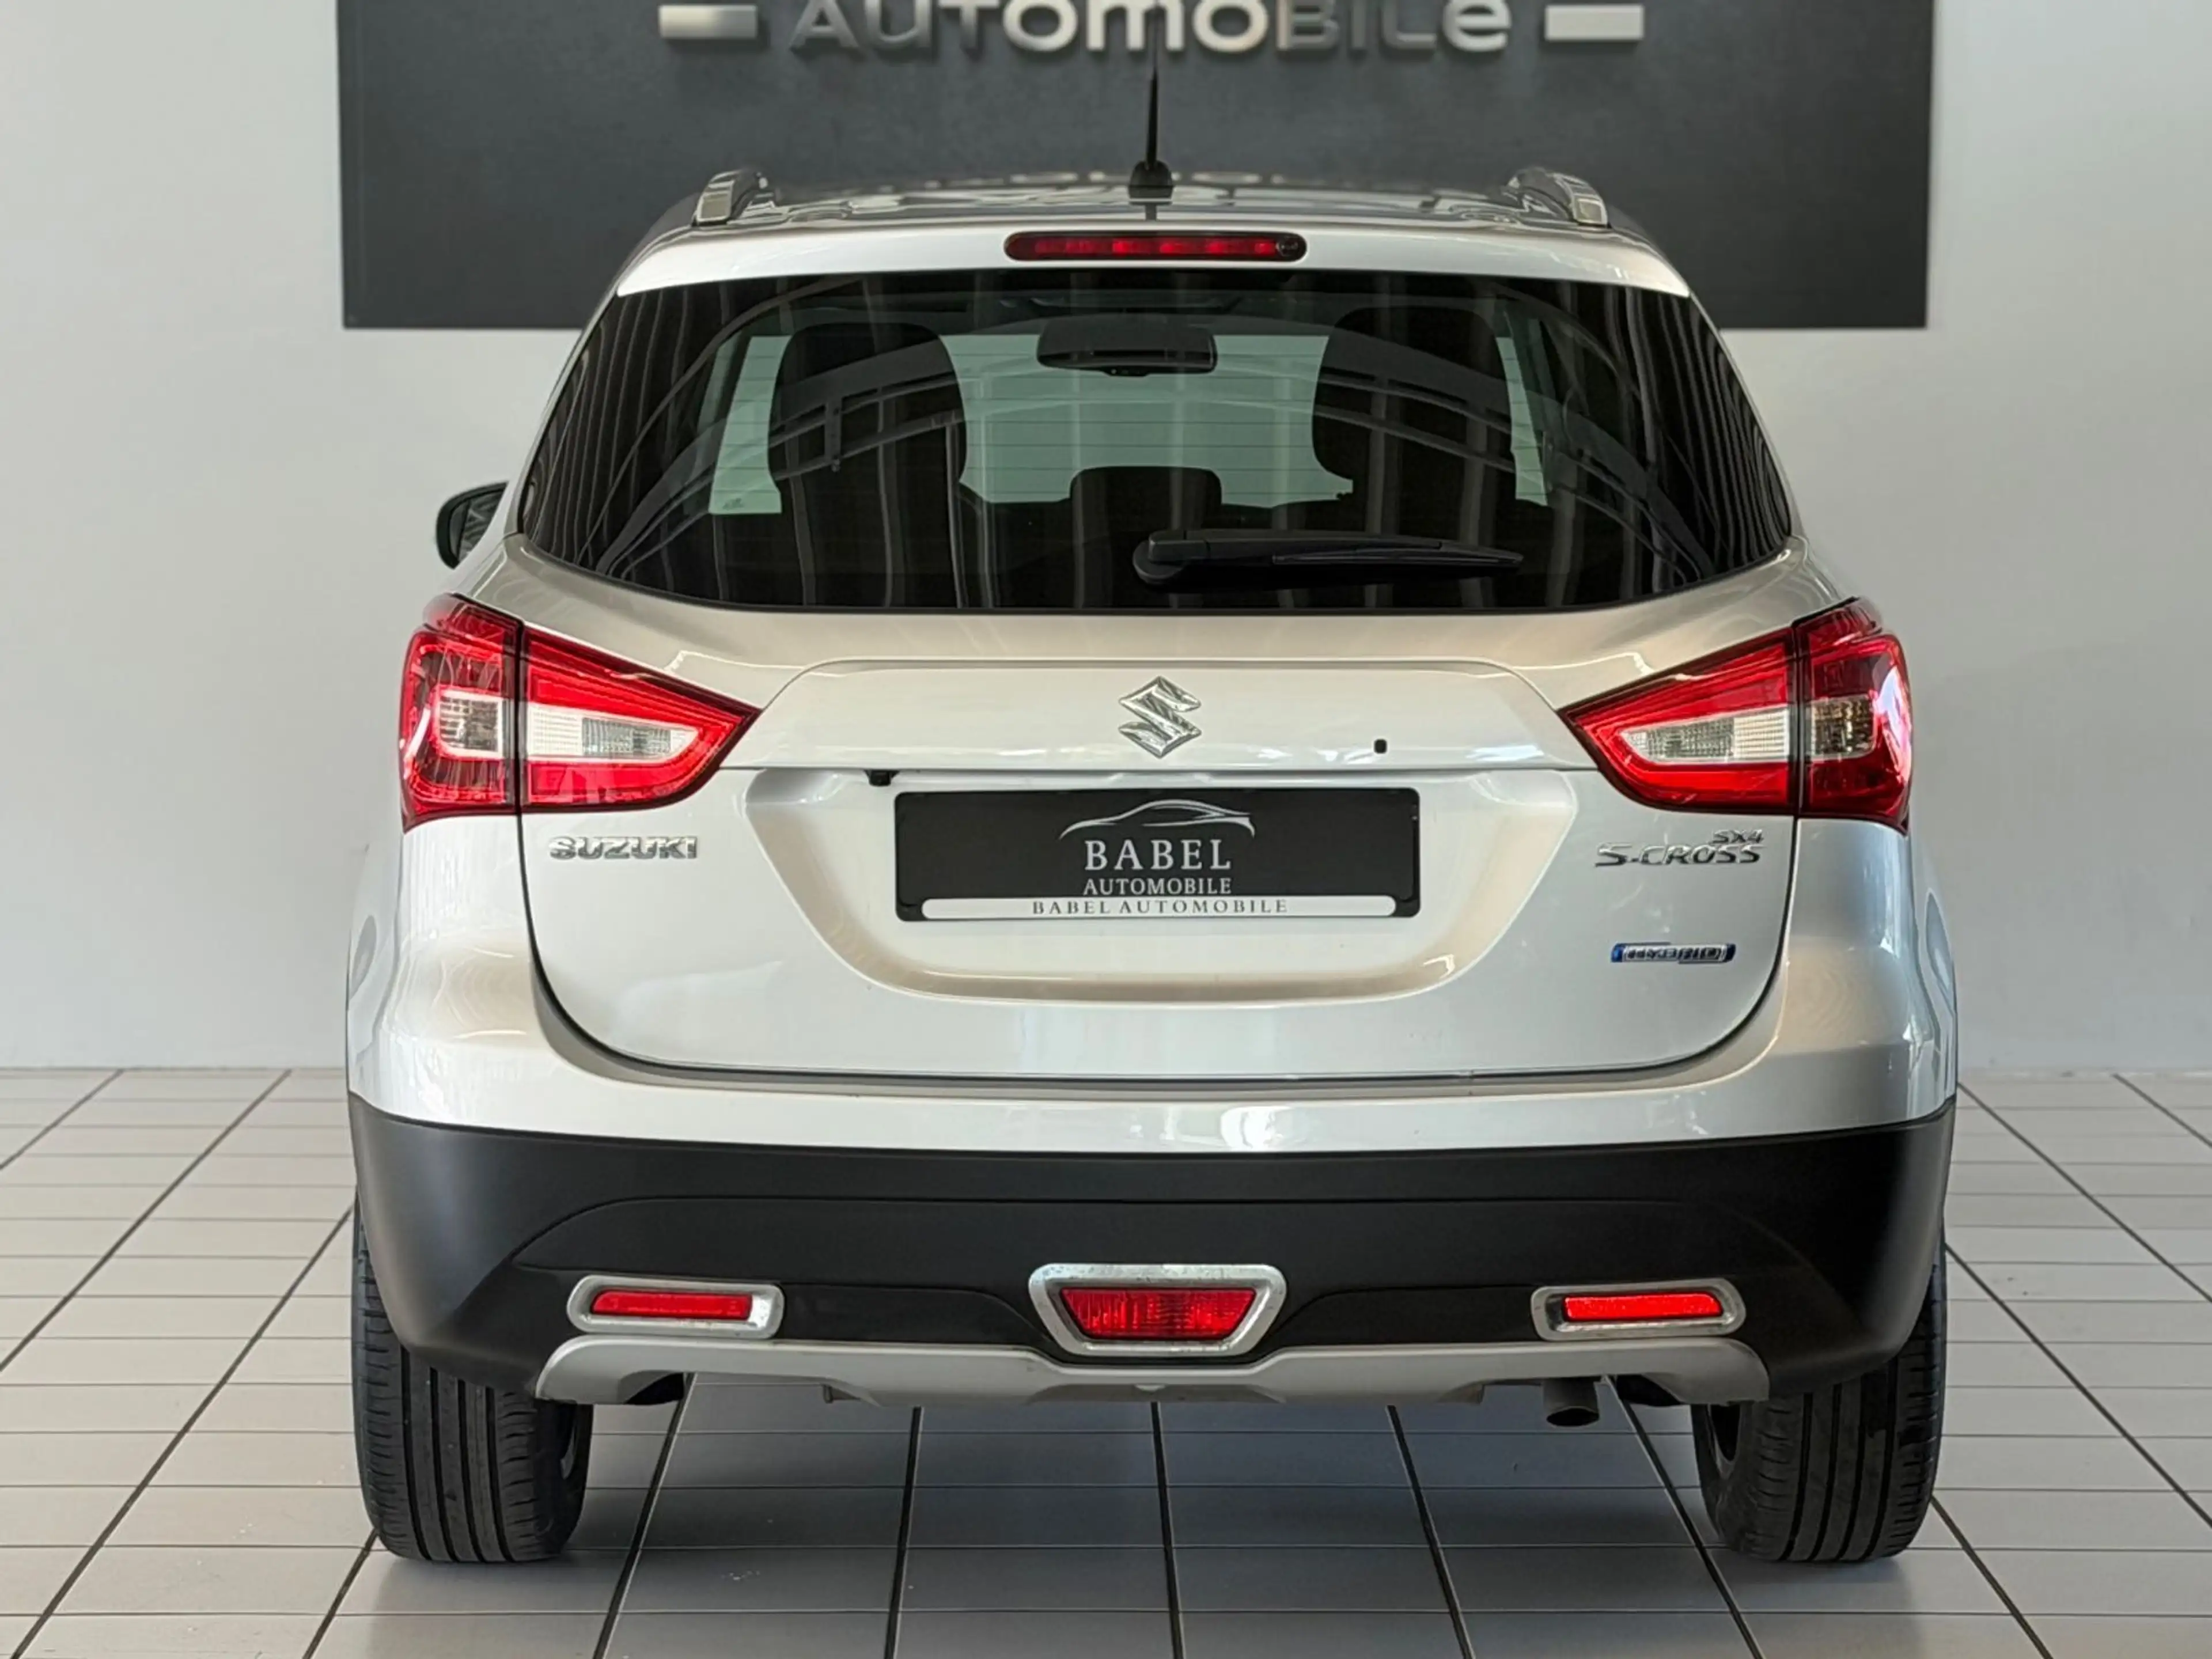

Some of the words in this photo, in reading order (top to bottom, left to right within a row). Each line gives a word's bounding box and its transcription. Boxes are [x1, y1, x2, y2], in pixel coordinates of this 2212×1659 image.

[1711, 828, 1764, 843] SX4
[549, 836, 698, 859] SUZUKI
[1084, 839, 1232, 870] BABEL
[1594, 843, 1765, 866] S-CROSS
[1083, 878, 1232, 896] AUTOMOBILE
[1032, 900, 1112, 915] BABEL
[1119, 899, 1289, 914] AUTOMOBILE
